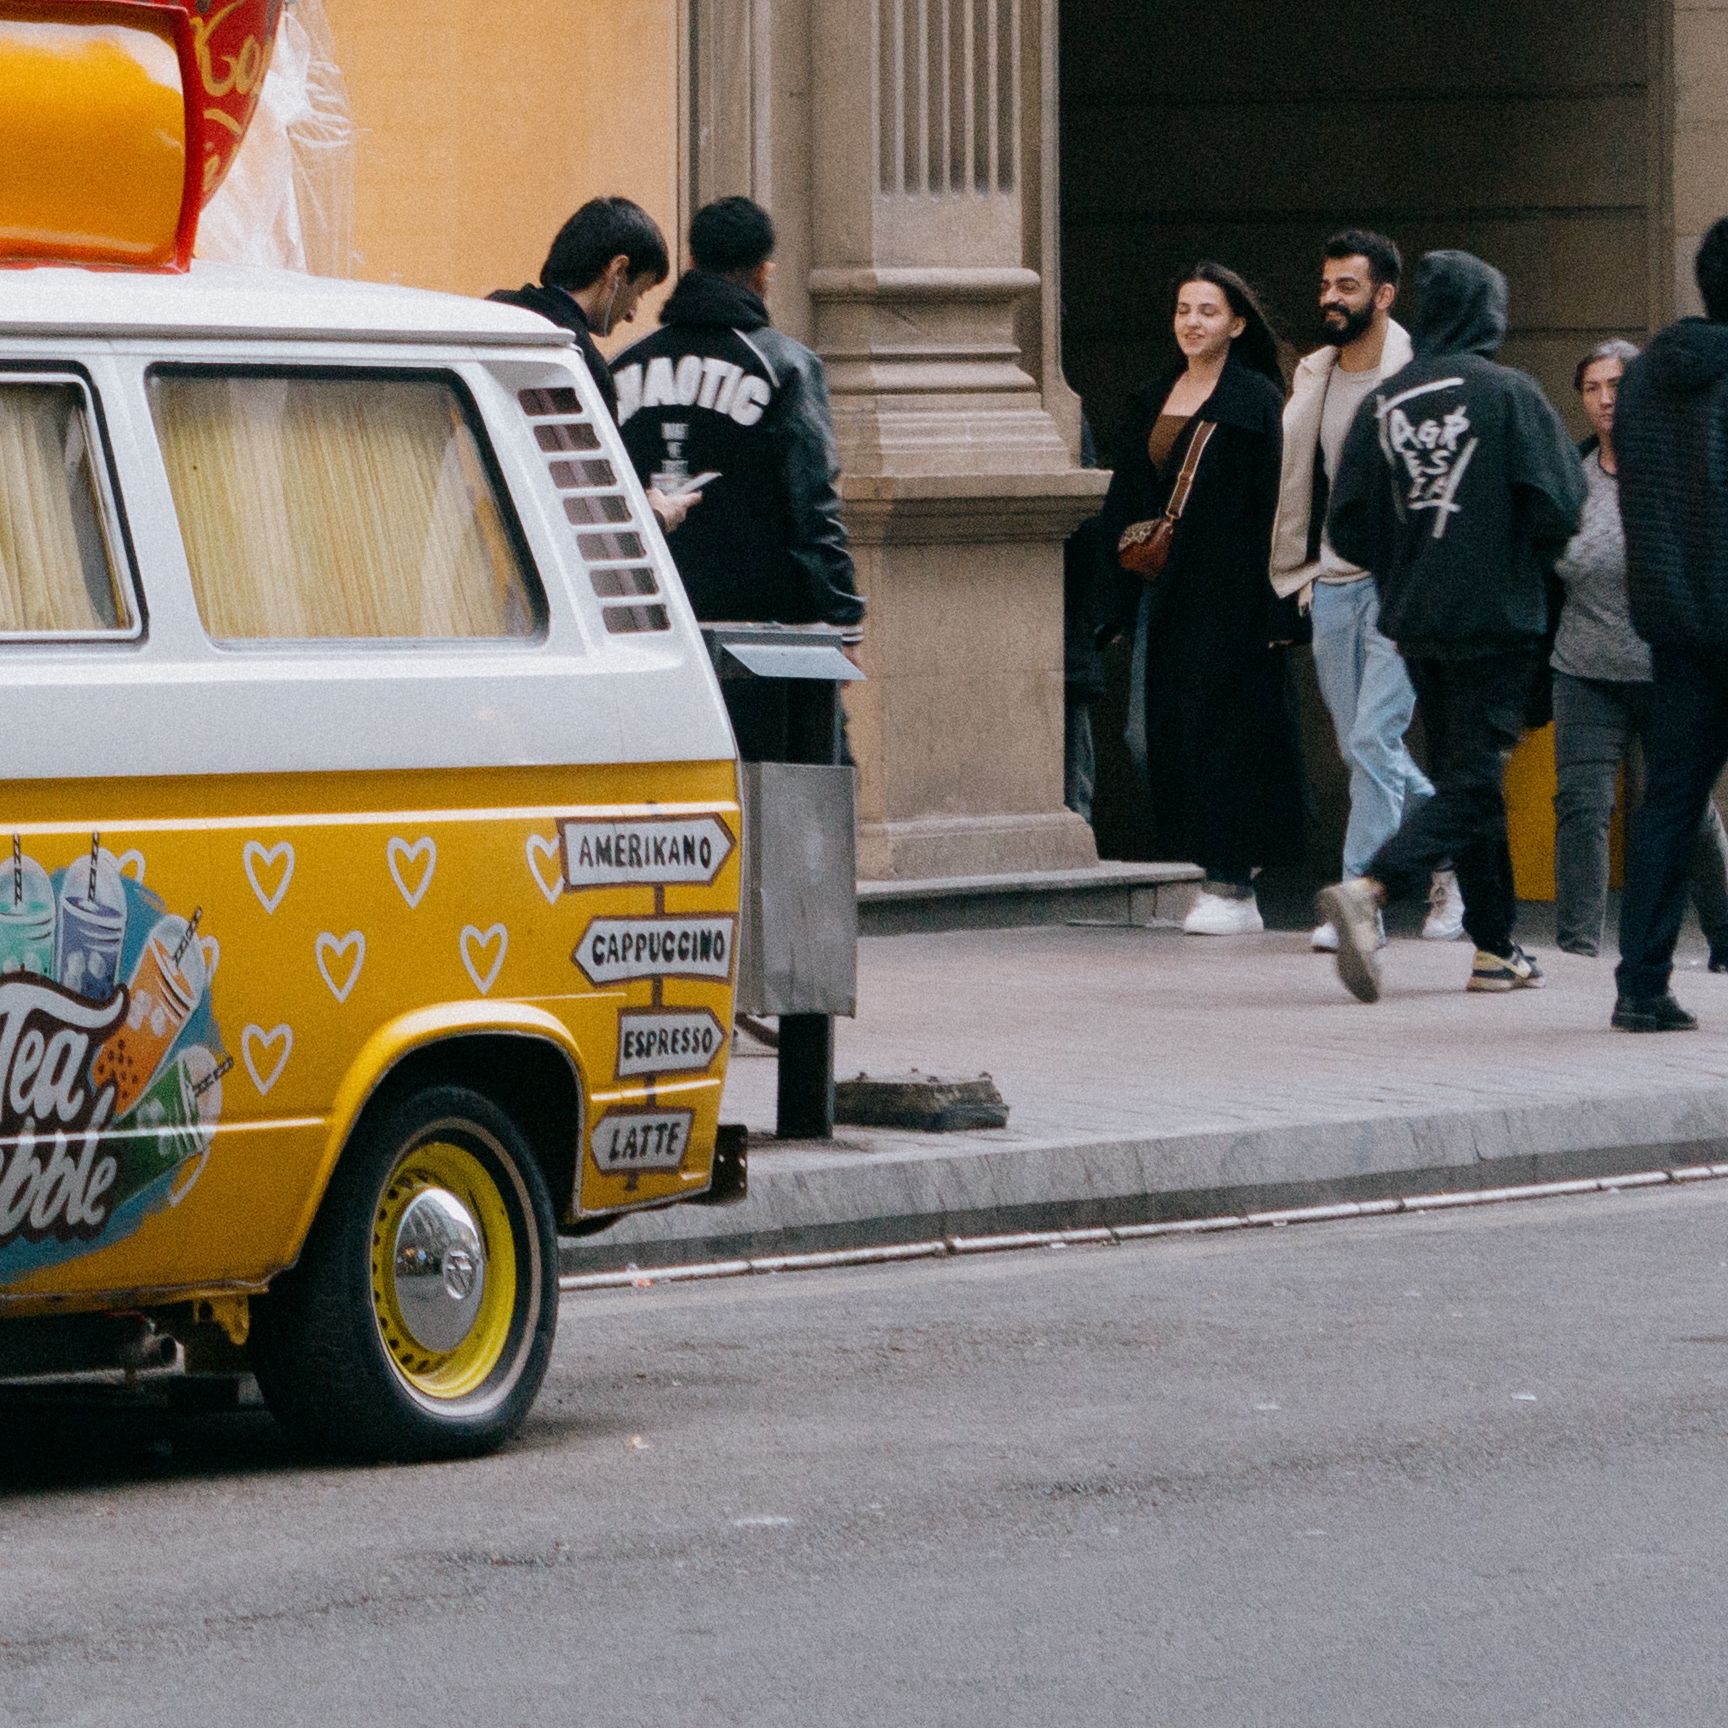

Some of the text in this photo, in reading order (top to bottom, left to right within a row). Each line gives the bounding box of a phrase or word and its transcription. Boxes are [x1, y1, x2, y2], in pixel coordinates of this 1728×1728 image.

[578, 832, 713, 869] AMERIKANO
[591, 927, 725, 967] CAPPUCCINO
[622, 1025, 714, 1061] ESPRESSO
[608, 1120, 682, 1163] LATTE
